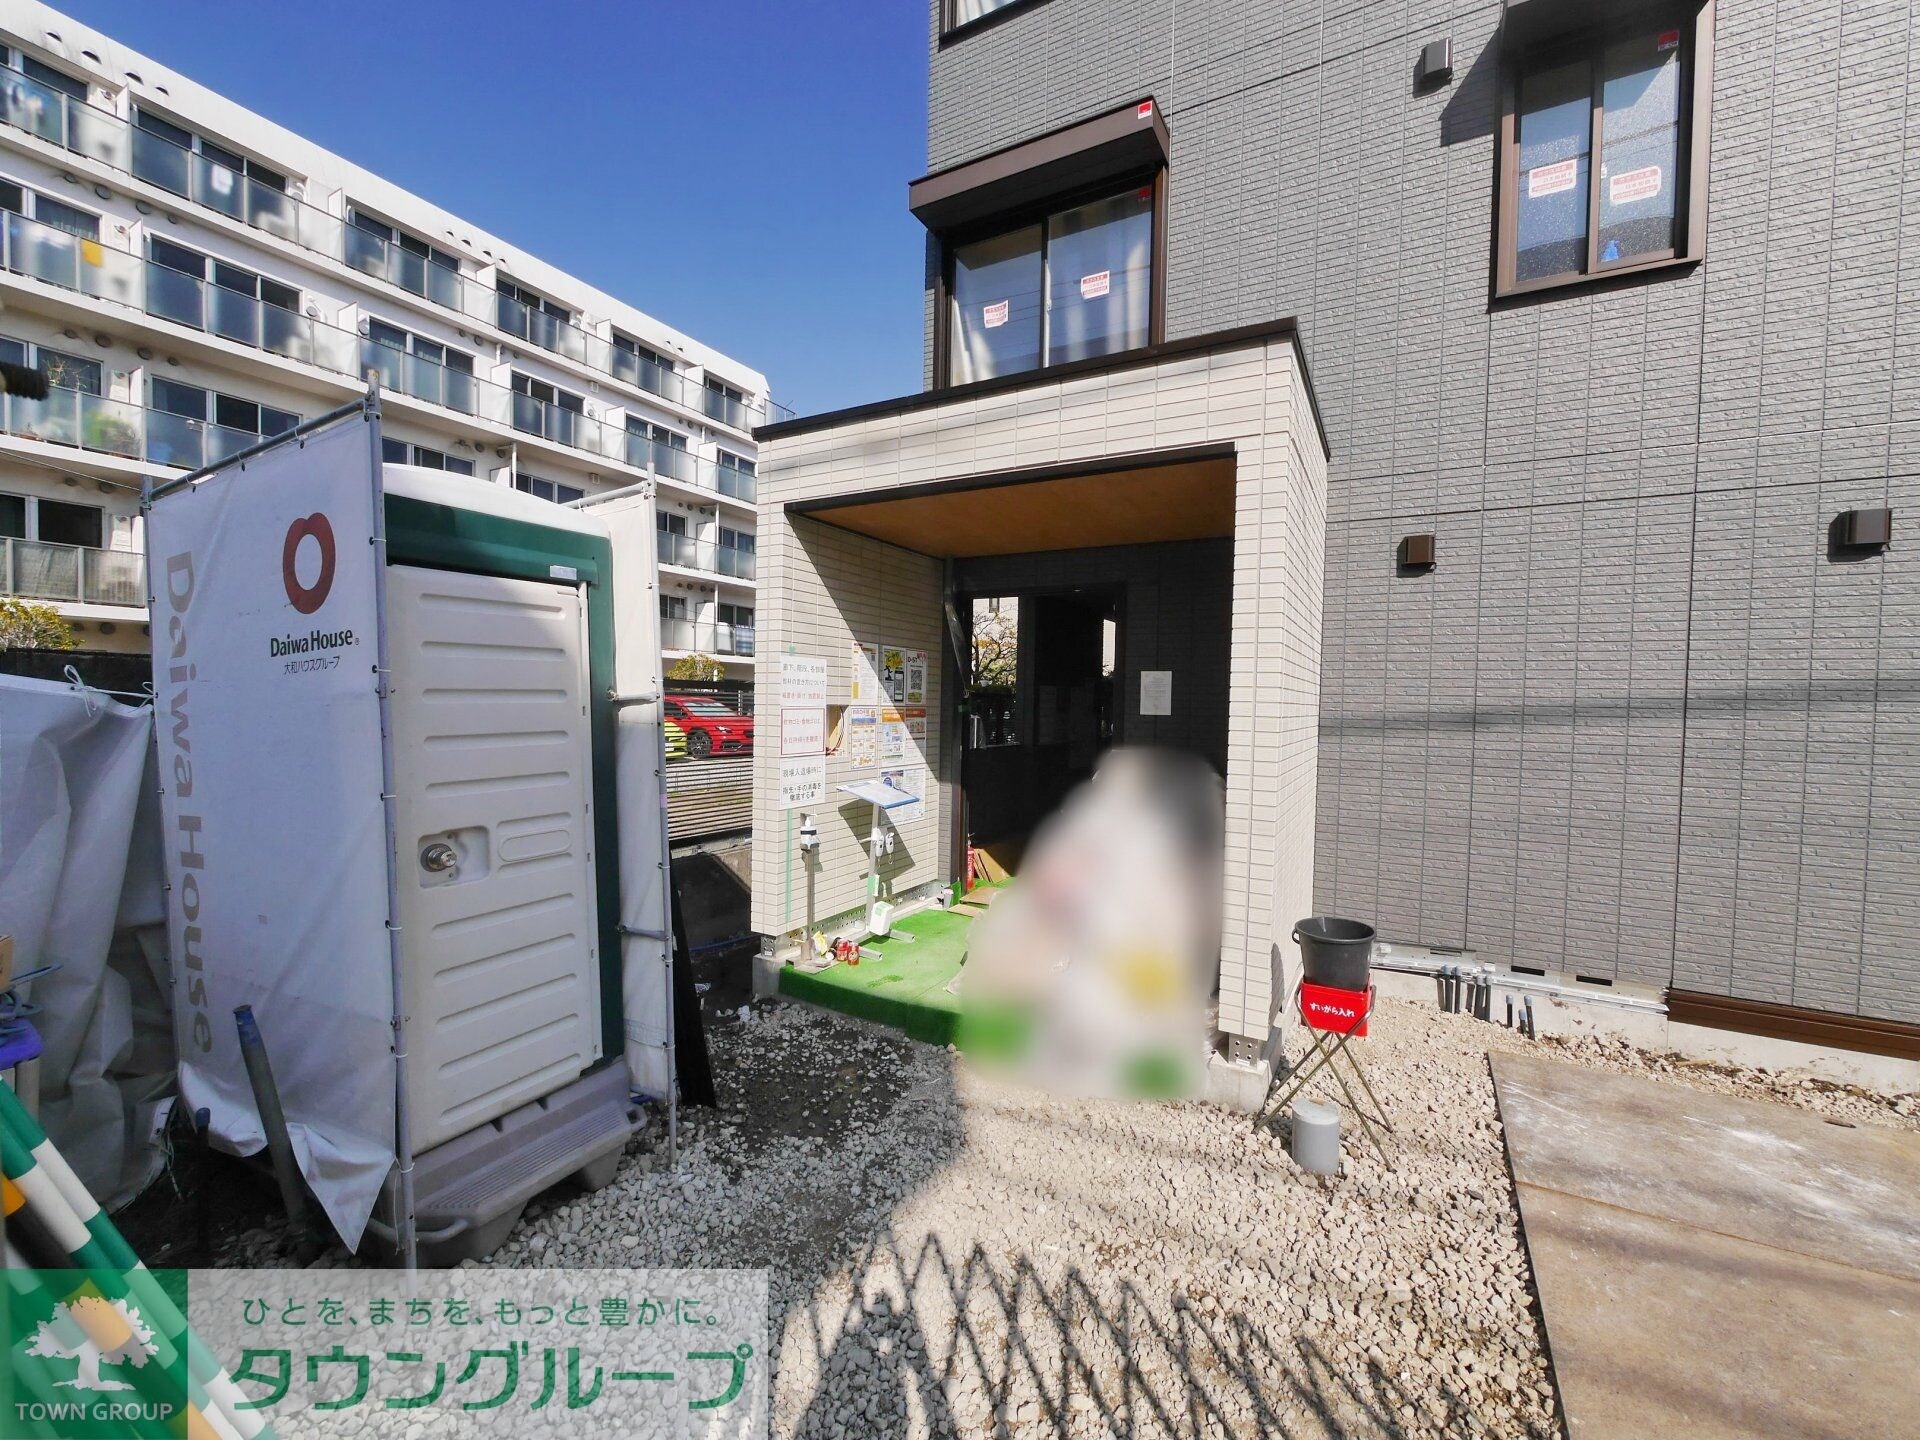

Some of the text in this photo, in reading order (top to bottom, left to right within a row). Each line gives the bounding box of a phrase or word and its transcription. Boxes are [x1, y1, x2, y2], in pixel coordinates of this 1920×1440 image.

[270, 630, 353, 657] Daiwa House
[167, 552, 213, 1052] Daiwa House
[1309, 1002, 1356, 1018] すいがら入れ
